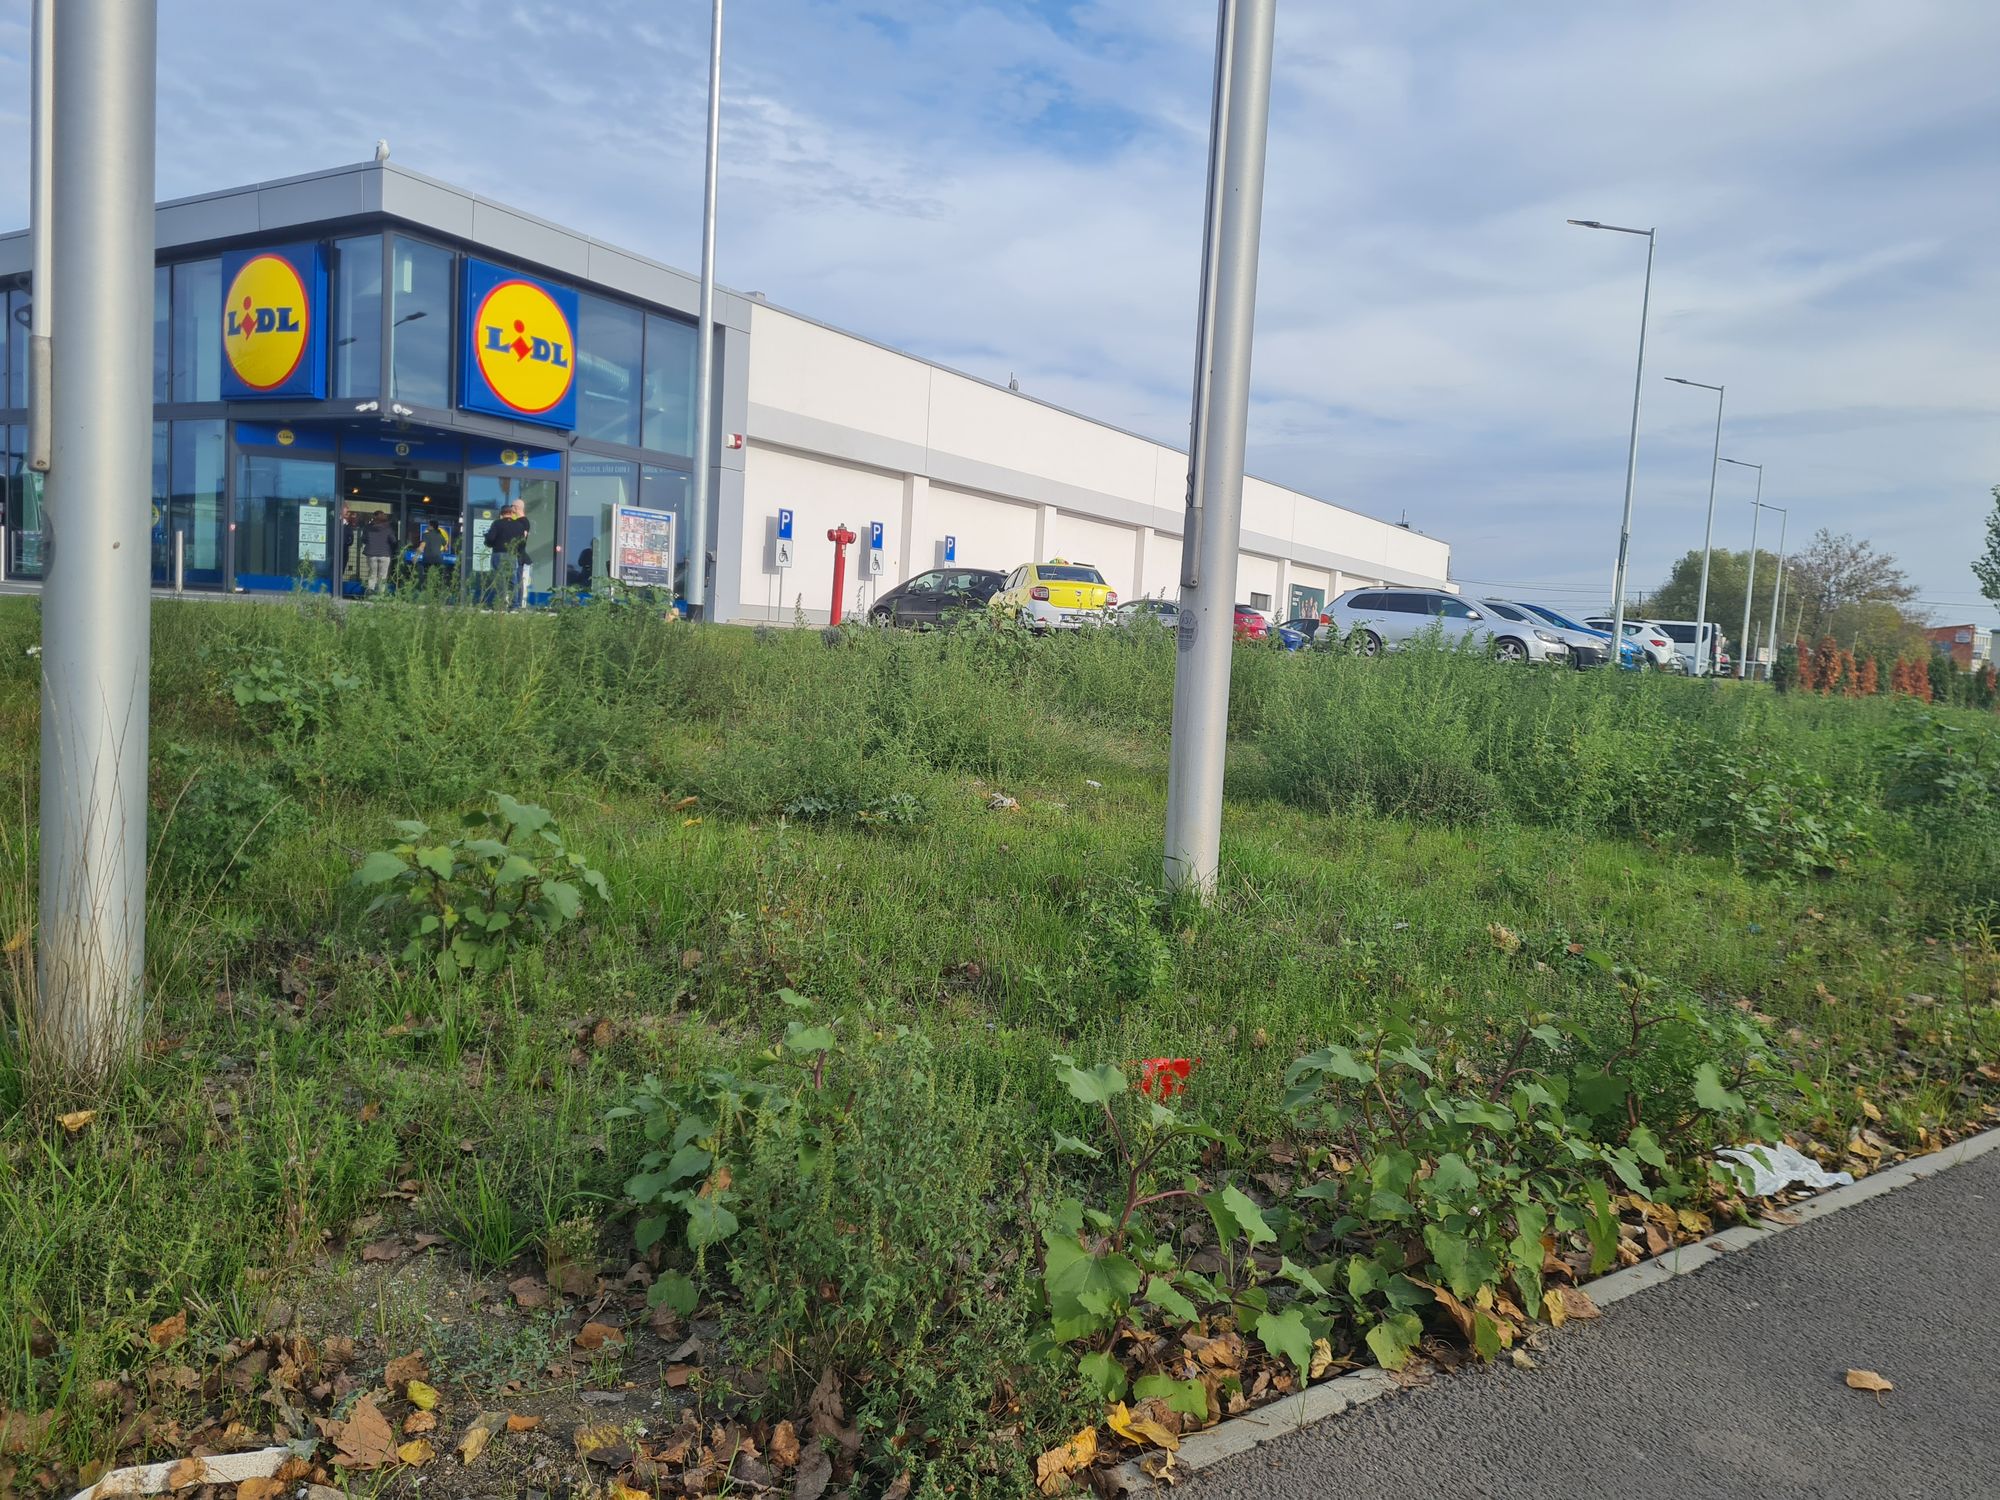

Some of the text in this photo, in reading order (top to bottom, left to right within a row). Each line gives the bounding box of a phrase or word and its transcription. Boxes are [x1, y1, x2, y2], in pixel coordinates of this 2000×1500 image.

[781, 511, 791, 530] P
[873, 524, 881, 541] P
[946, 538, 953, 553] P
